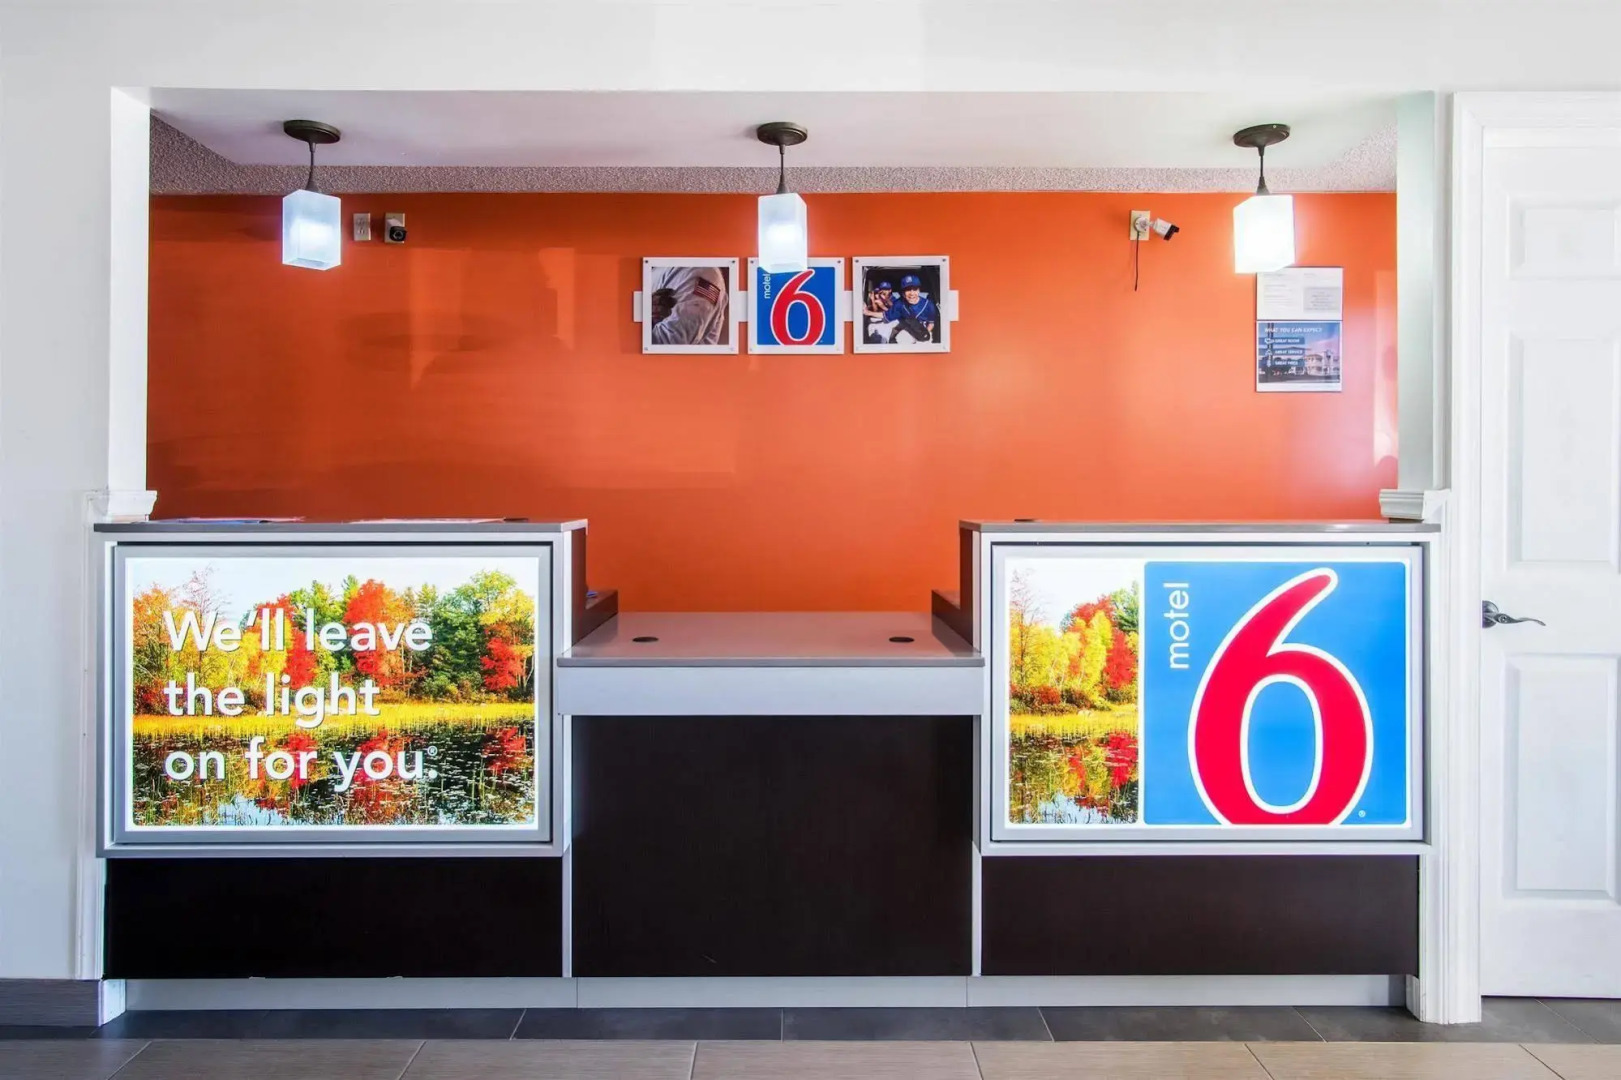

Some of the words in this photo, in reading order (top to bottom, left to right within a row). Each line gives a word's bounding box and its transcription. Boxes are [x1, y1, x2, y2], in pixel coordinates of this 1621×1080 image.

[762, 273, 771, 299] motel
[770, 268, 826, 345] 6
[163, 607, 285, 652] We'll
[304, 607, 434, 652] leave
[1163, 581, 1190, 670] motel
[163, 671, 246, 717] the
[265, 671, 381, 729] light
[1187, 567, 1374, 828] 6
[164, 748, 226, 782] on
[245, 736, 319, 782] for
